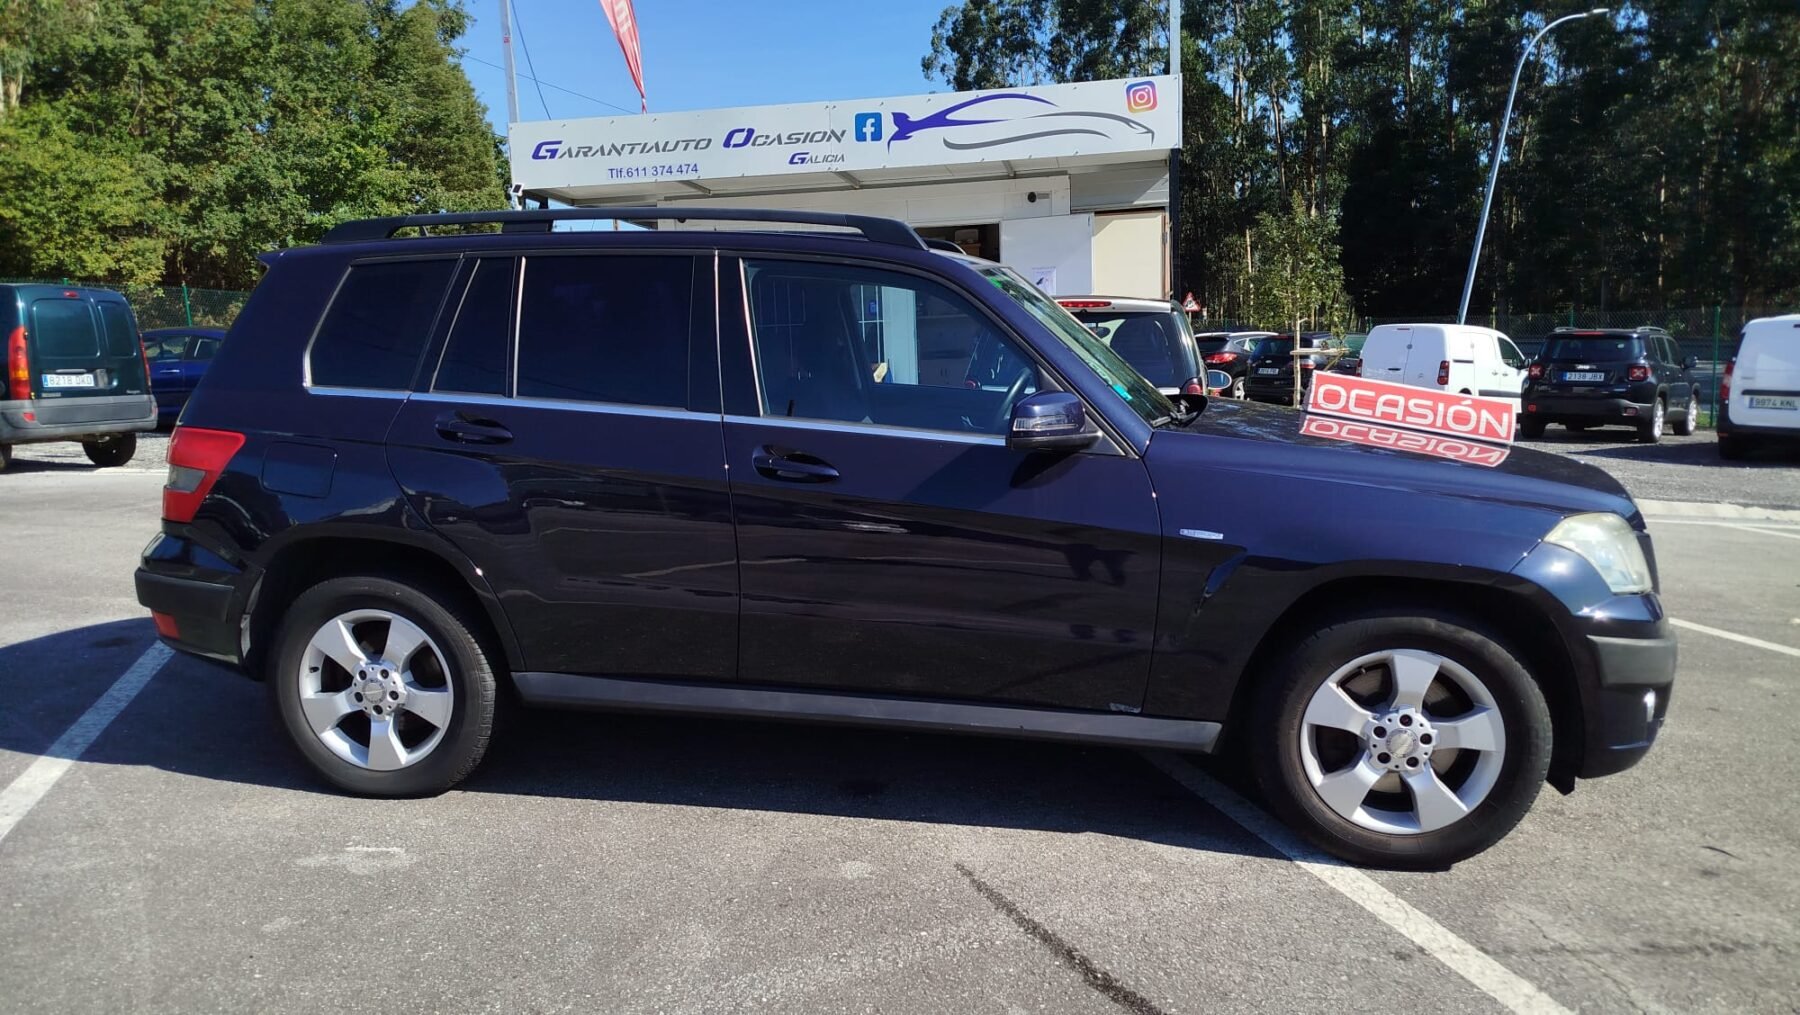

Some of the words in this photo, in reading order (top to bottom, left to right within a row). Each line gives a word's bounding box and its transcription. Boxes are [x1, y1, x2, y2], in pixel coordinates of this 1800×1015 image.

[532, 138, 713, 160] GARANTIAUTO
[723, 128, 846, 149] OCASION
[788, 152, 845, 165] GALICIA
[608, 167, 647, 179] Tlf.611
[651, 165, 673, 176] 374
[676, 163, 699, 174] 474
[1317, 383, 1509, 438] OCASIÓN
